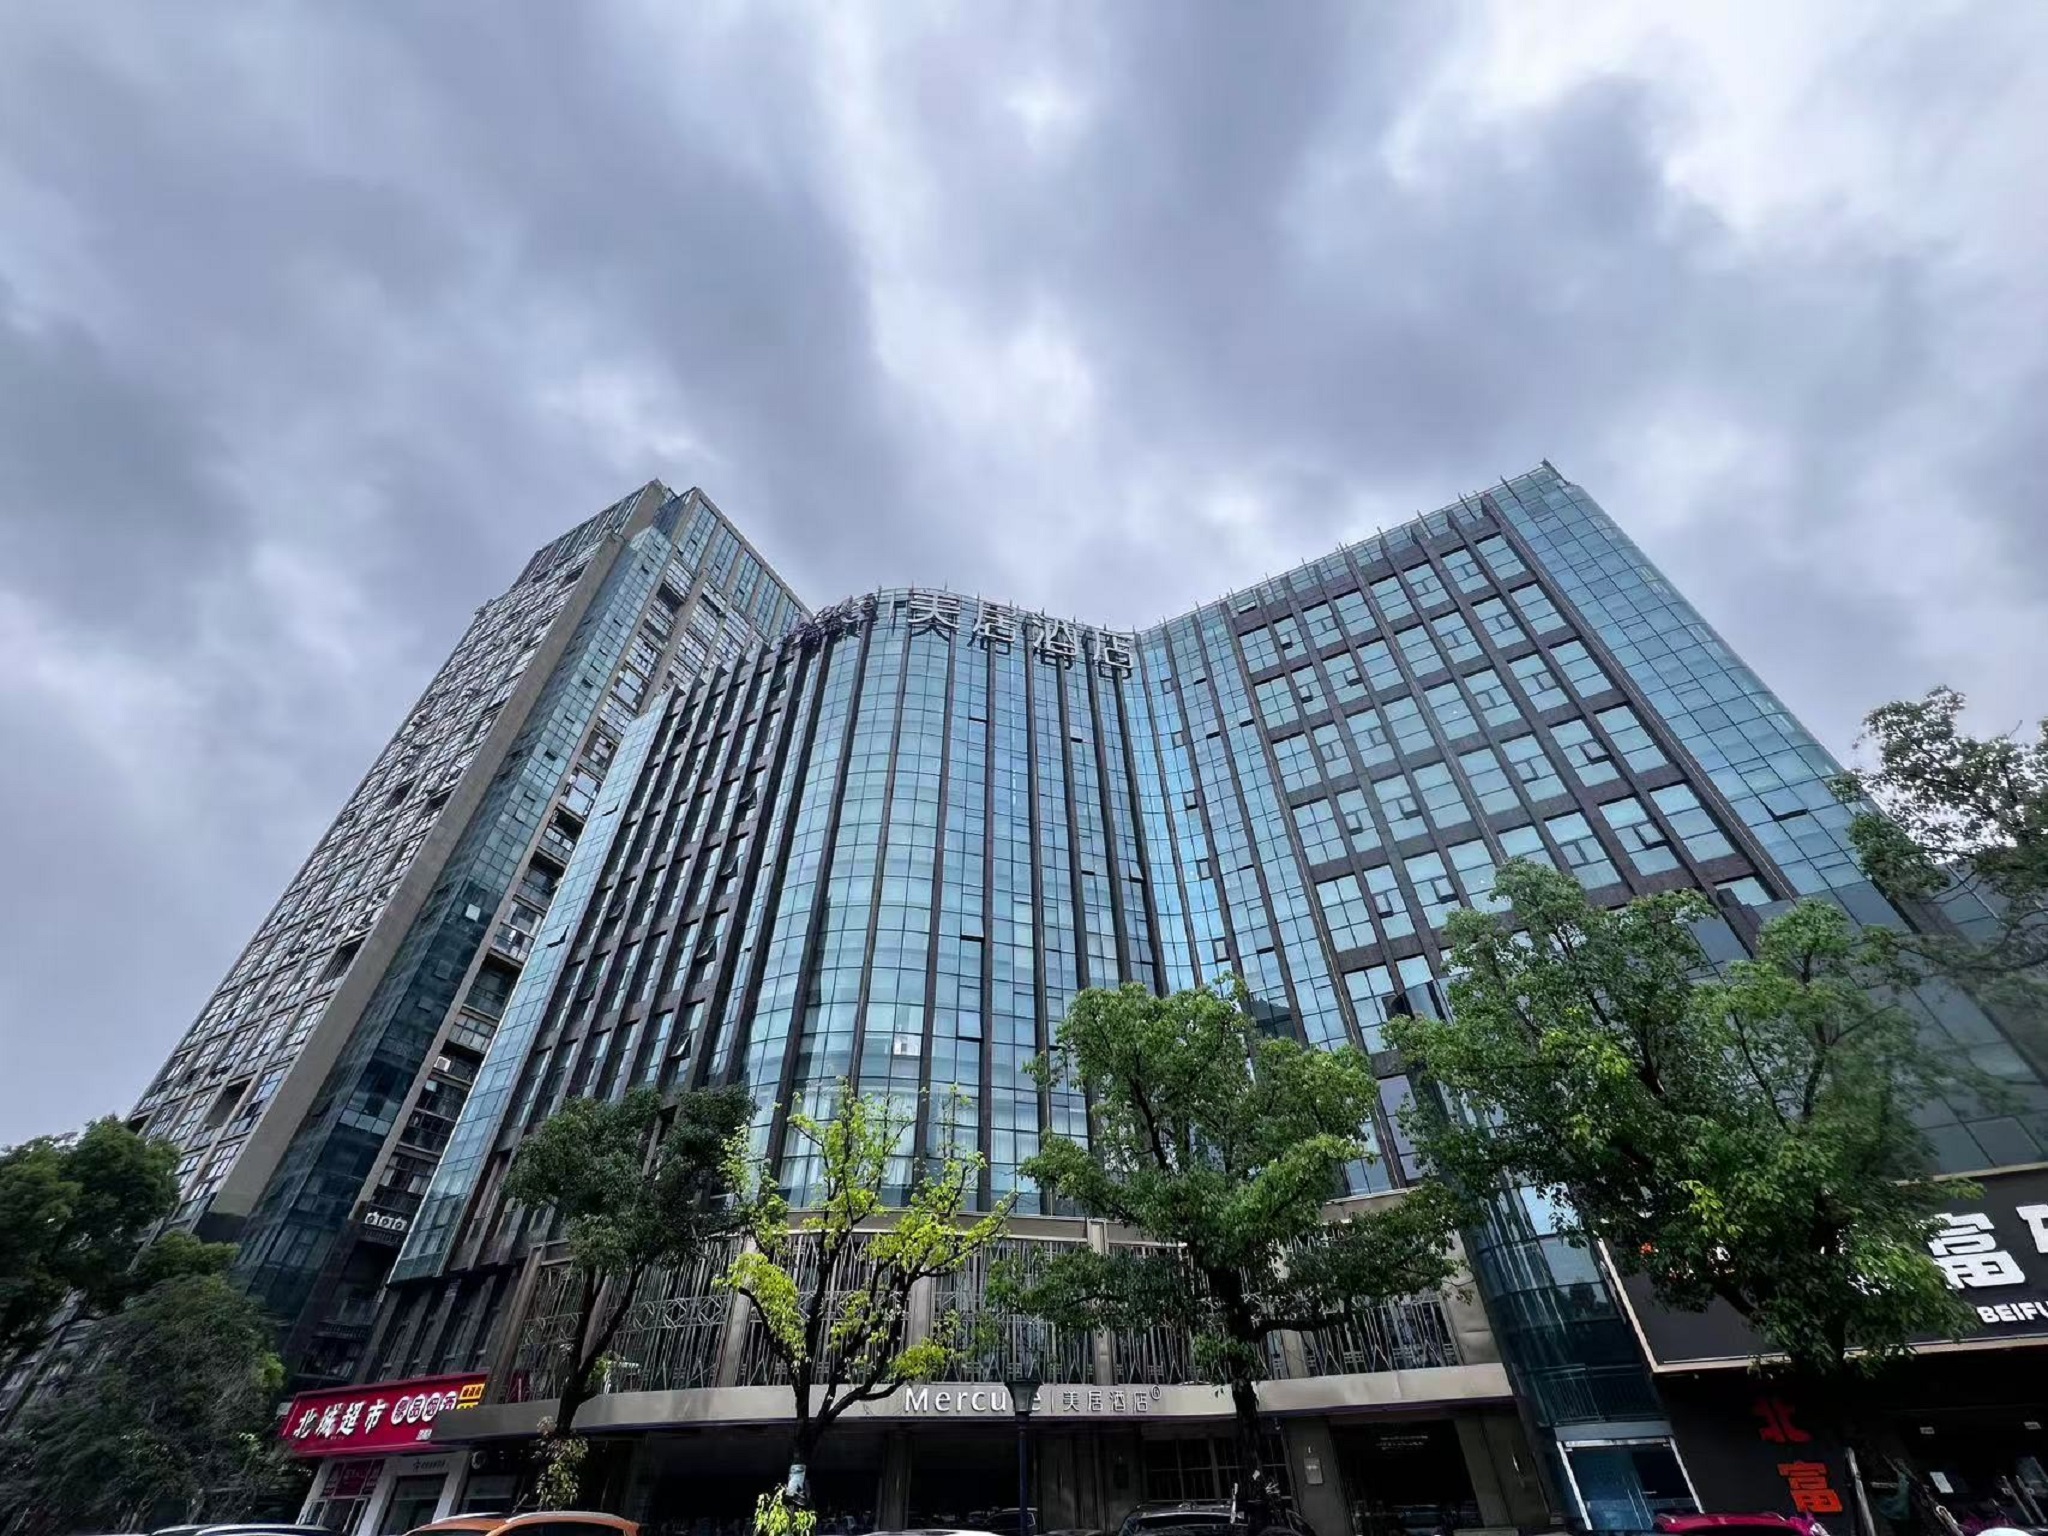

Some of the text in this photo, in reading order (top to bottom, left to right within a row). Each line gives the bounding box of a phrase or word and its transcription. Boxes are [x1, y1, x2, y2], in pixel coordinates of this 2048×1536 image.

[908, 592, 1135, 669] 美居酒店
[904, 1387, 1041, 1412] Mercue
[1062, 1389, 1149, 1412] 美居酒店
